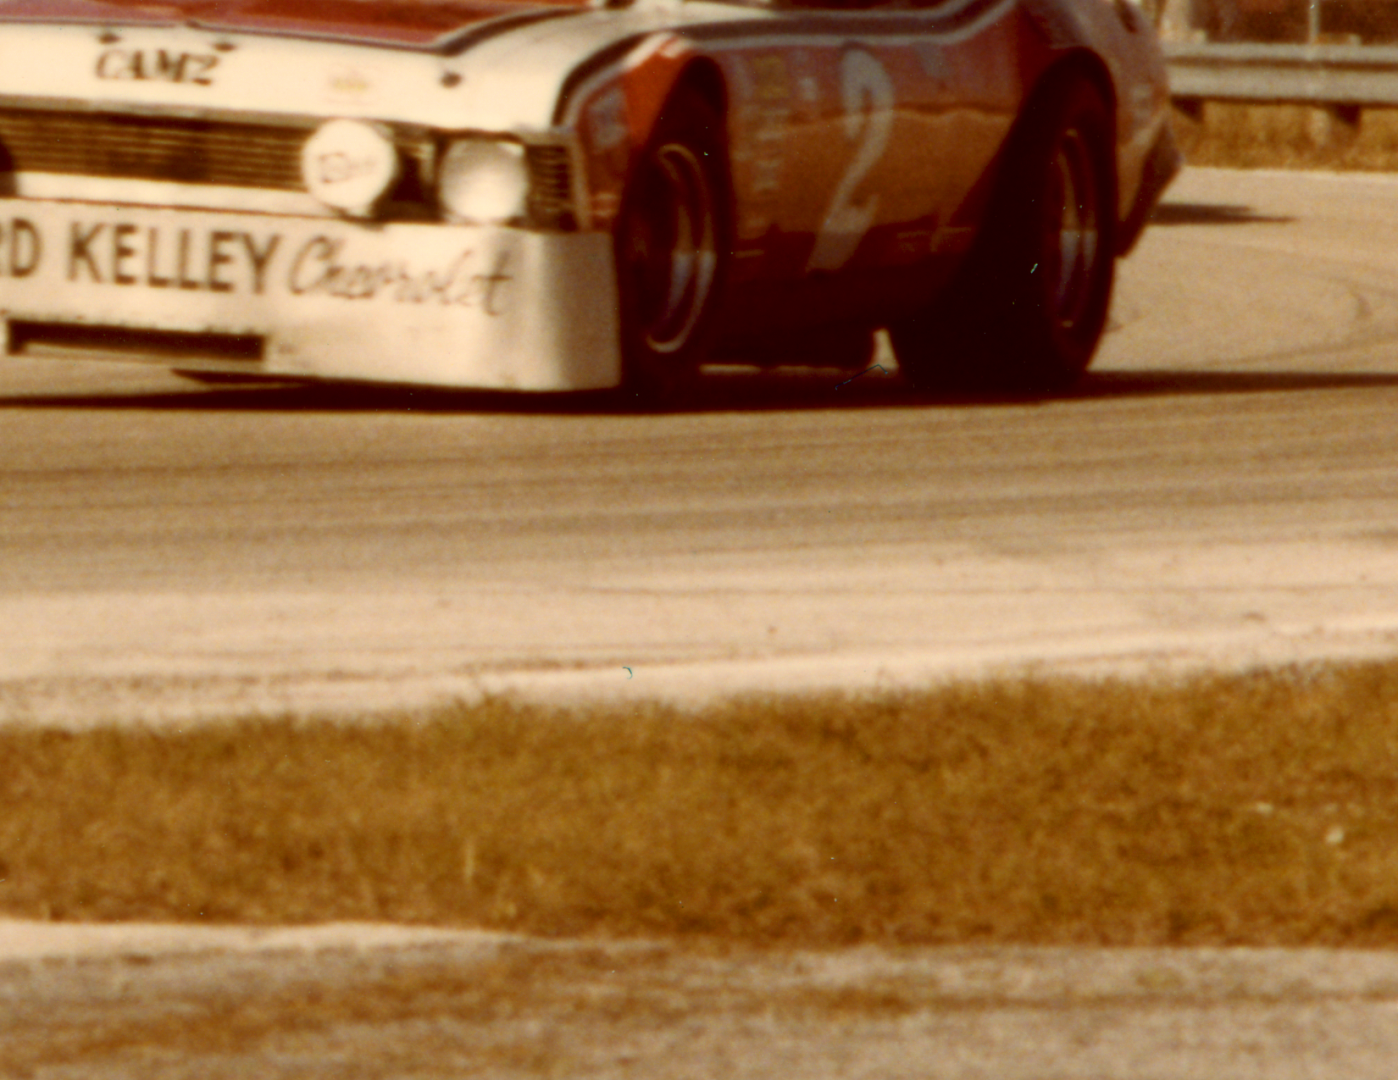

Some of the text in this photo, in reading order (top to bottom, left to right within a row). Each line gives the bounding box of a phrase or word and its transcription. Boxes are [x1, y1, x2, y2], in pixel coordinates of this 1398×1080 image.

[806, 47, 895, 272] 2
[66, 220, 283, 296] KELLEY
[288, 234, 515, 318] Chevrolet
